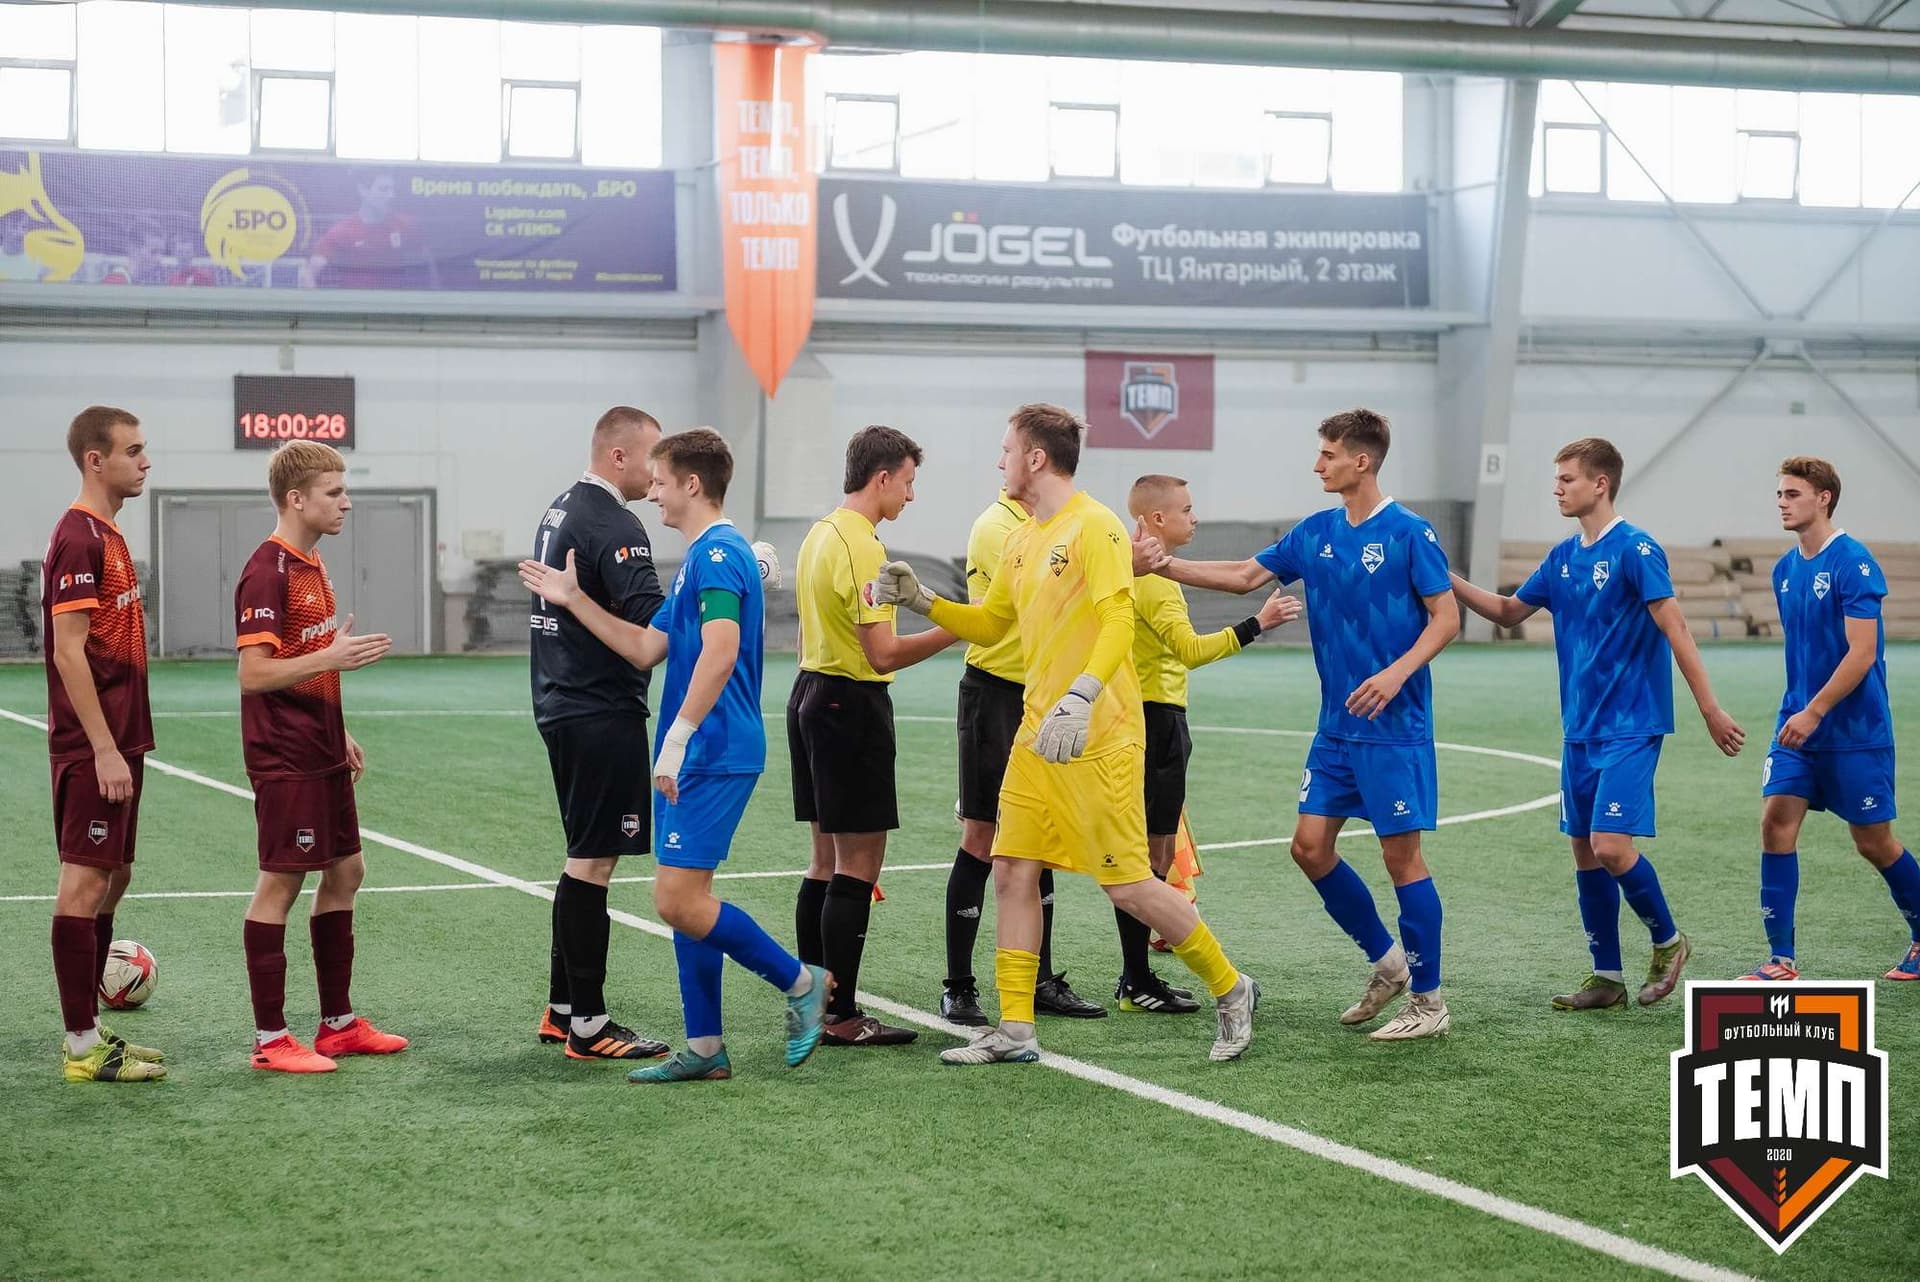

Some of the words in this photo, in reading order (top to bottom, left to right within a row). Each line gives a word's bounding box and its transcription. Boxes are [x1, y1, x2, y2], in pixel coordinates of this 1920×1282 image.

[411, 176, 472, 198] Время
[477, 178, 588, 200] побеждать,
[592, 179, 637, 199] .БРО
[227, 208, 287, 231] .БРО
[728, 191, 810, 227] ТОЛЬКО
[902, 210, 1114, 268] JÖGEL
[1111, 222, 1268, 252] Футбольная
[1273, 228, 1422, 253] экипировка
[740, 236, 800, 271] ТЕМП!
[1137, 255, 1174, 284] ТЦ
[1179, 256, 1310, 286] Янтарный,
[1315, 257, 1331, 282] 2
[1336, 261, 1398, 283] этаж
[240, 413, 346, 439] 18:00:26
